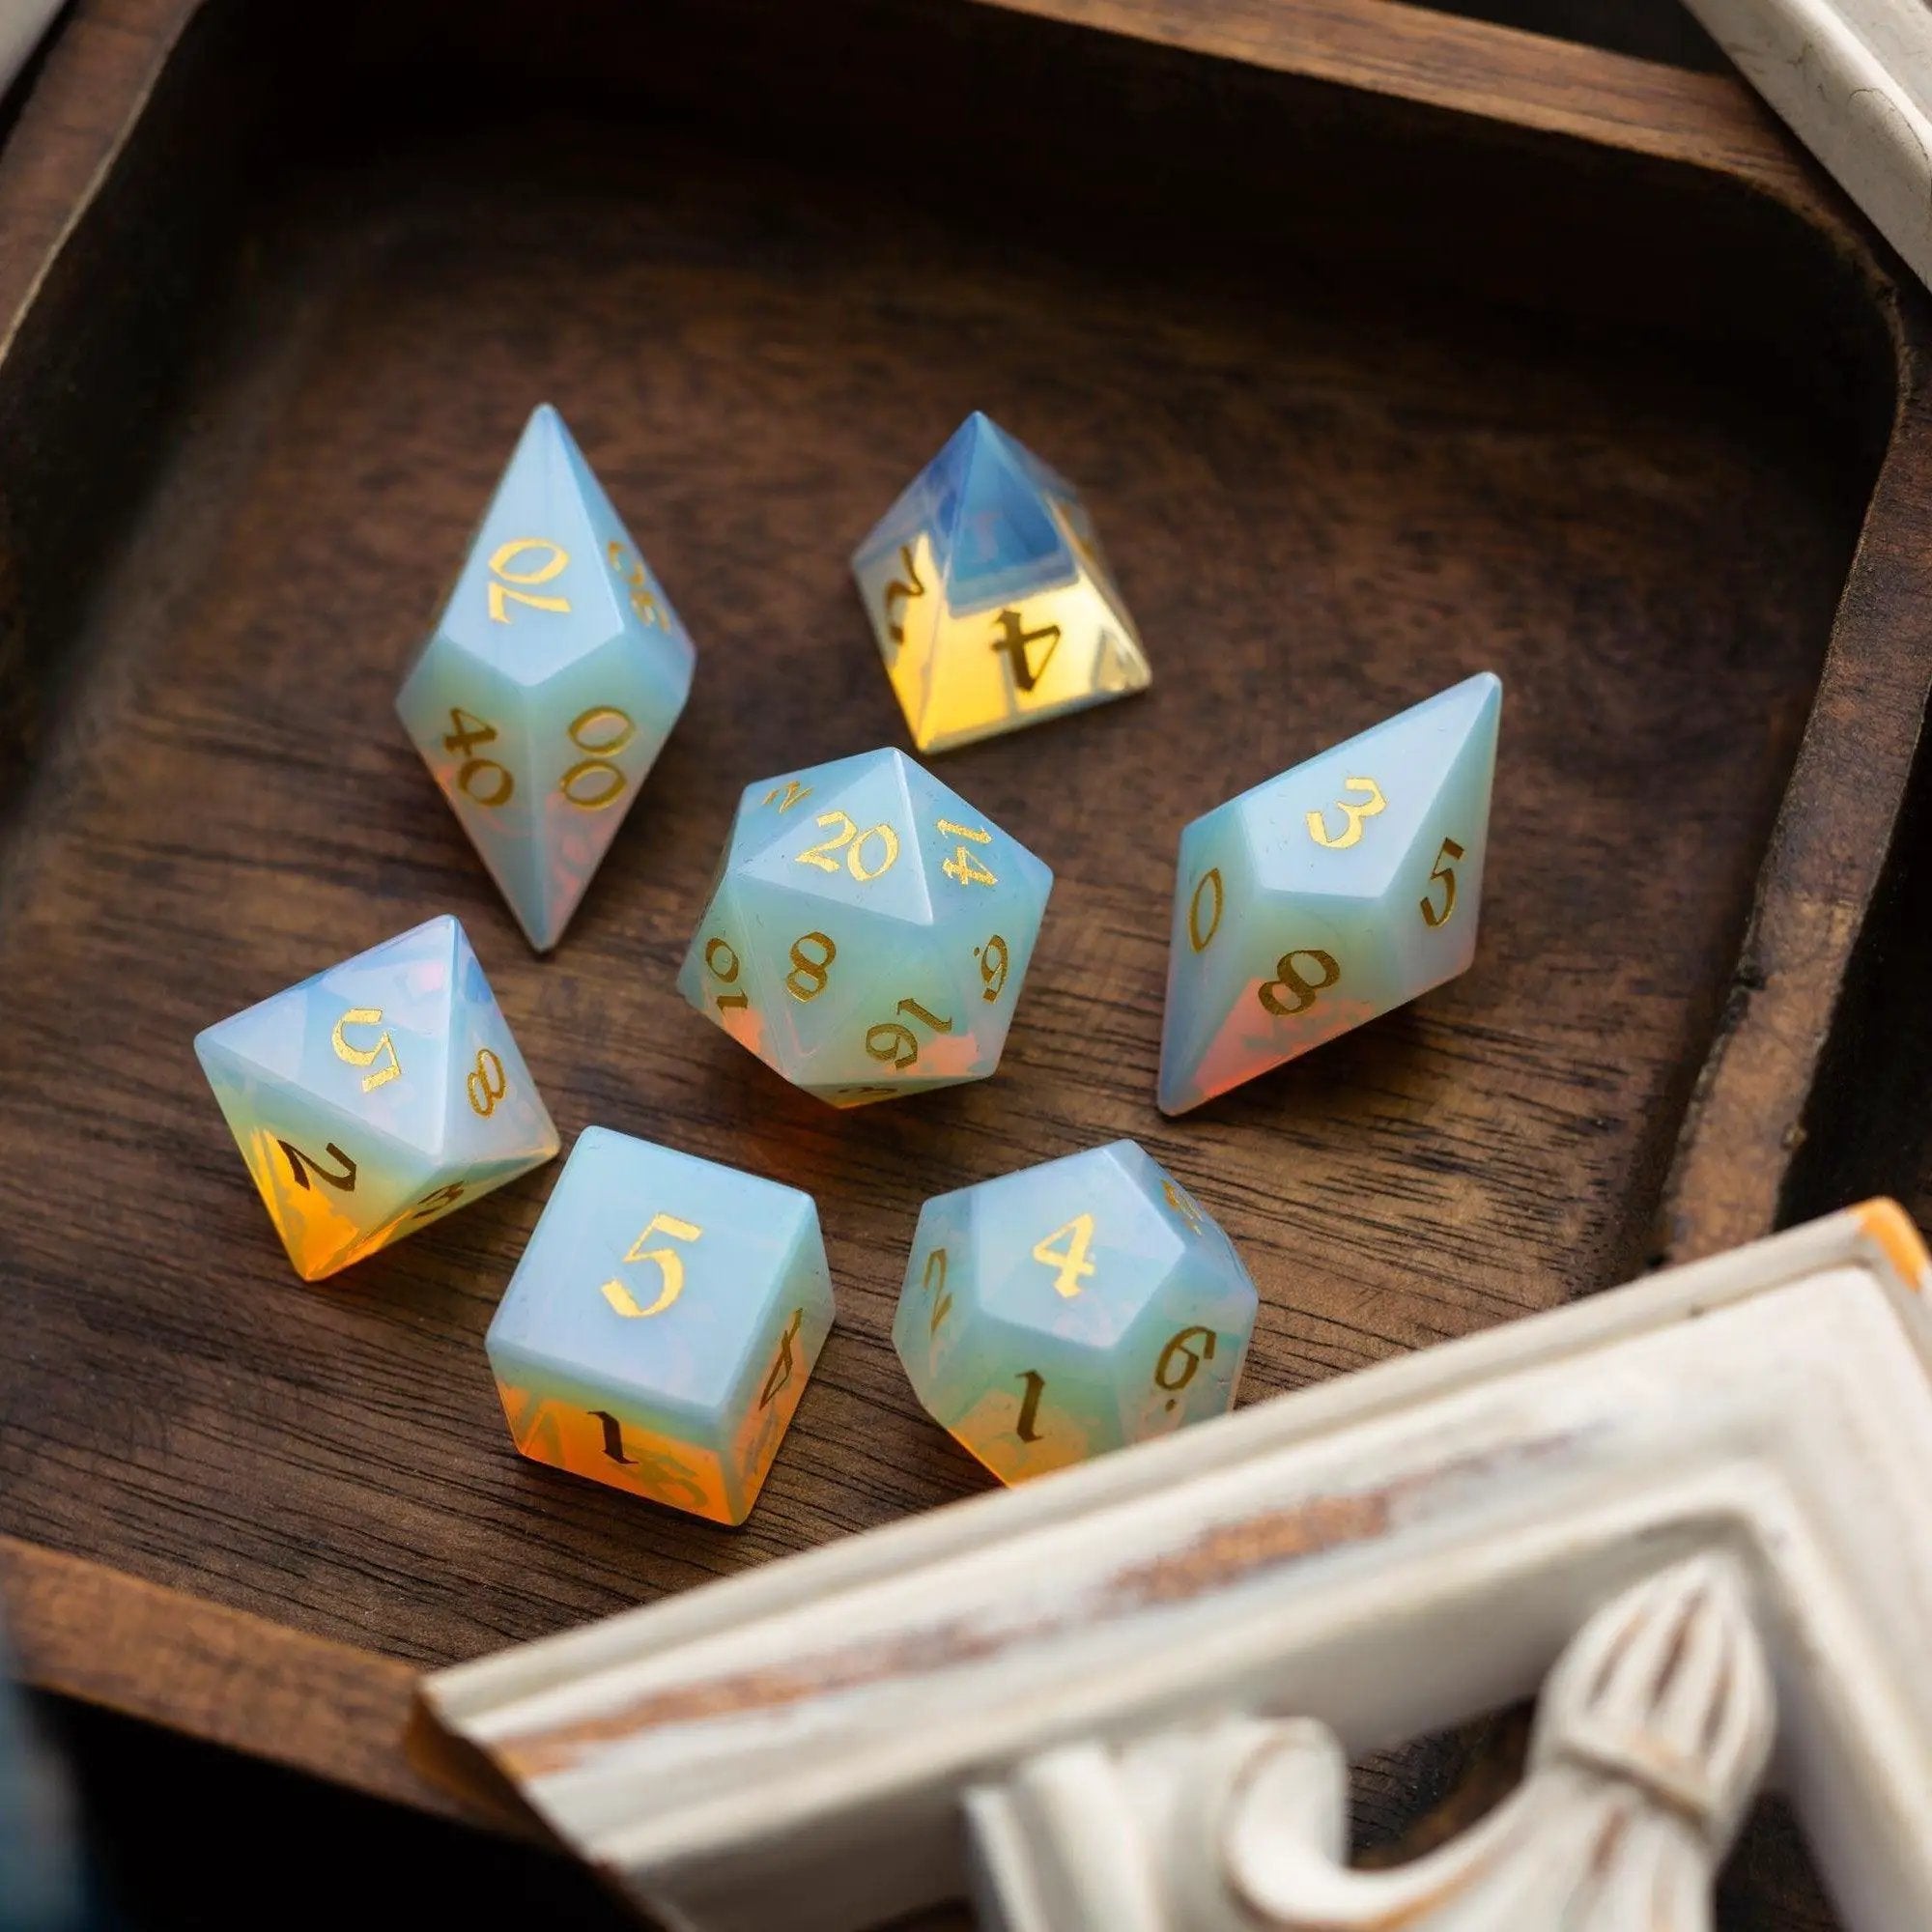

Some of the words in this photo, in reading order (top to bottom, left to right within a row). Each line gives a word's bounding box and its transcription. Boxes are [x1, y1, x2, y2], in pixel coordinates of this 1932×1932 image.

[488, 537, 573, 624] 70
[990, 609, 1062, 696] 4
[442, 707, 514, 808] 40
[559, 705, 637, 811] 00
[795, 810, 900, 882] 20
[936, 818, 999, 887] 14
[1305, 776, 1388, 849] 3
[1188, 867, 1223, 953] 0
[1419, 837, 1465, 928] 5
[704, 937, 749, 1017] 10
[785, 930, 838, 1004] 8
[1258, 950, 1341, 1016] 8
[331, 1008, 402, 1094] 5
[866, 997, 953, 1069] 16
[468, 1048, 507, 1119] 8
[276, 1142, 357, 1192] 2
[600, 1211, 703, 1319] 5
[923, 1248, 953, 1334] 2
[1033, 1213, 1096, 1299] 4
[586, 1409, 639, 1465] 1
[1014, 1369, 1046, 1444] 1
